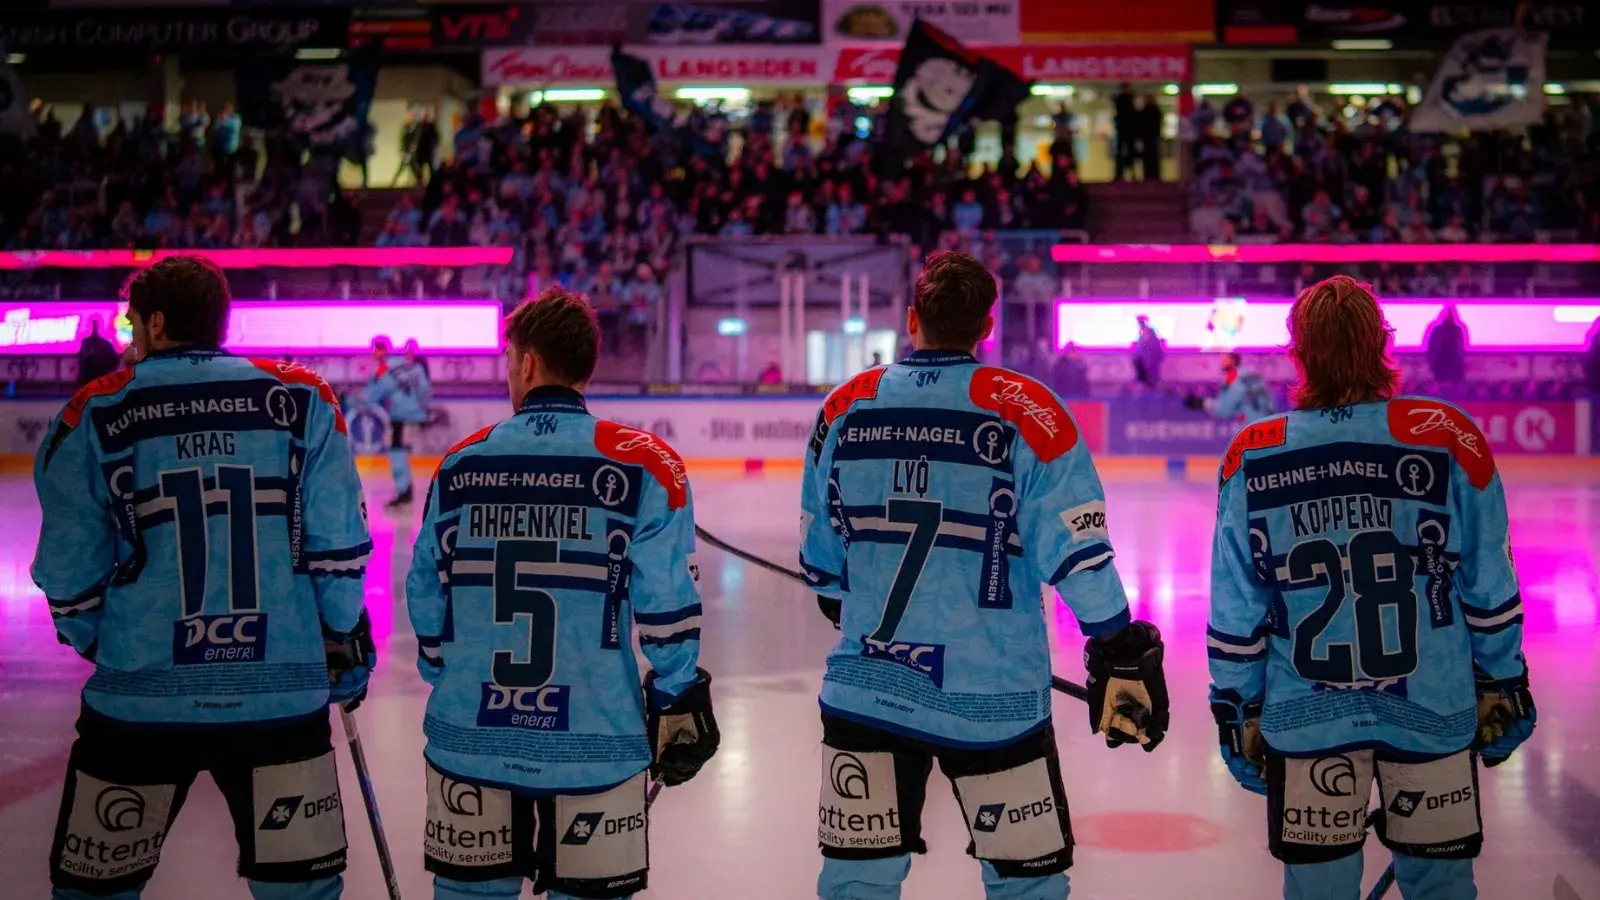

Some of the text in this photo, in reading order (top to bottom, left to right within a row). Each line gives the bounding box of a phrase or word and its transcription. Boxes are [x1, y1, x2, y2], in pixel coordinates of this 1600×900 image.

[659, 58, 816, 78] LANGSIDEN
[175, 432, 236, 461] KRAG
[837, 426, 966, 449] EHNE+NAGEL
[469, 504, 592, 541] AHRENKIEL
[158, 463, 260, 619] 11
[866, 496, 943, 646] 7
[490, 538, 558, 689] 5
[1286, 529, 1420, 684] 28
[183, 615, 259, 648] DCC
[204, 645, 255, 662] energi
[487, 685, 560, 712] DCC
[511, 713, 556, 729] energi
[304, 792, 340, 819] DFDS
[1008, 796, 1053, 825] DFDS
[1426, 785, 1473, 811] DFDS
[604, 812, 644, 836] DFDS
[819, 804, 900, 832] attent
[64, 831, 162, 864] attent
[426, 819, 513, 849] attent
[850, 833, 901, 846] services
[1283, 827, 1362, 844] facility servi
[60, 854, 104, 878] facility
[459, 850, 513, 863] services
